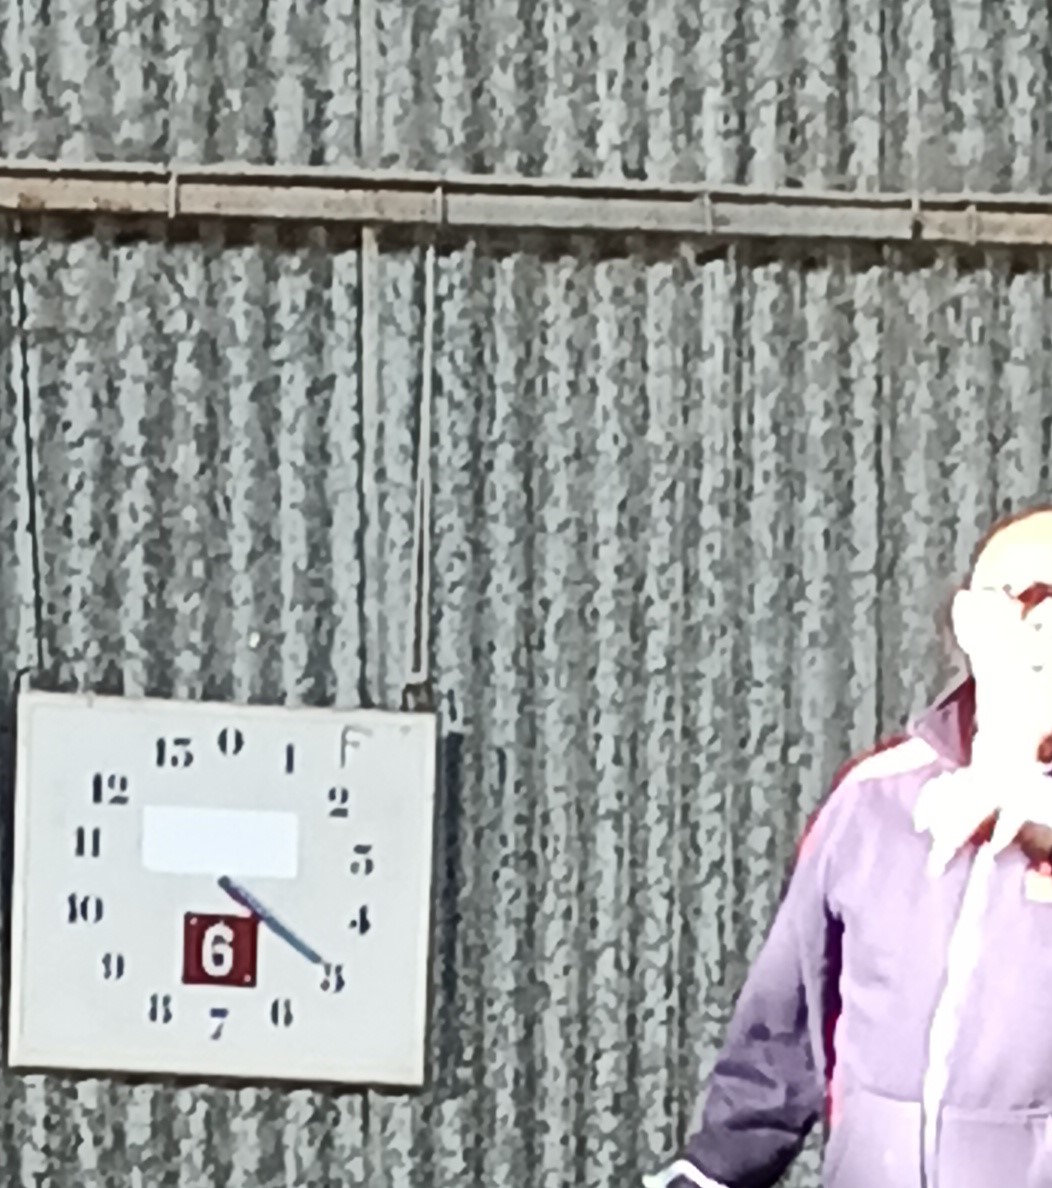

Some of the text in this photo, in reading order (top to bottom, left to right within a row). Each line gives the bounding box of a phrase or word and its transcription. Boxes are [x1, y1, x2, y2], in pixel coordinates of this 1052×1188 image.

[218, 727, 244, 756] 0
[285, 744, 295, 774] 1
[92, 773, 129, 805] 12
[328, 786, 349, 817] 2
[75, 826, 101, 857] 11
[68, 893, 103, 924] 10
[349, 905, 371, 935] 4
[201, 922, 234, 977] 6
[102, 953, 124, 980] 9
[210, 1008, 229, 1040] 7
